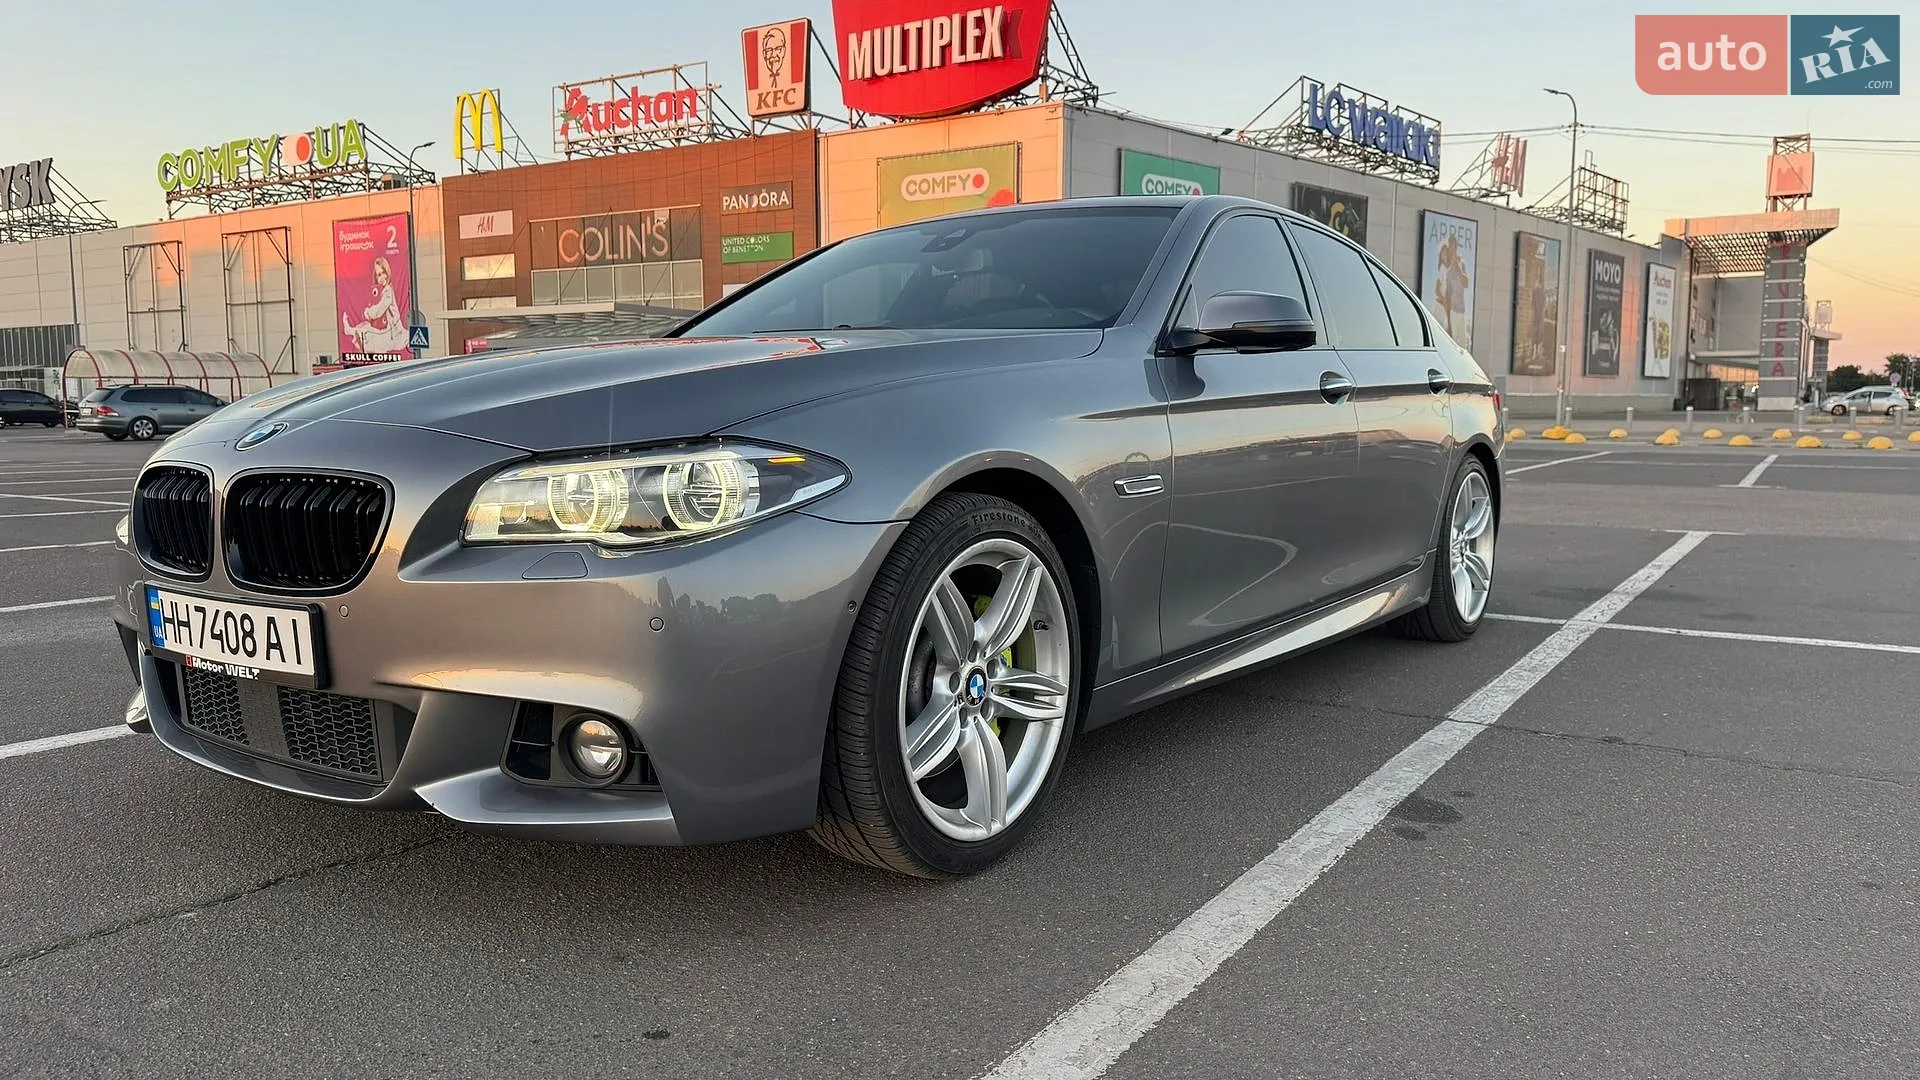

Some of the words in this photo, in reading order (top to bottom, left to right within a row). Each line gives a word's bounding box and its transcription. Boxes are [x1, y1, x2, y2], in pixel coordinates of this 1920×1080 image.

[849, 5, 1004, 81] MULTIPLEX
[756, 87, 796, 111] KFC
[560, 86, 697, 136] Auchan
[157, 133, 279, 192] COMFY
[315, 118, 367, 168] UA
[905, 173, 971, 196] COMFY
[1145, 178, 1192, 195] COMFY
[386, 225, 398, 248] 2
[558, 215, 669, 264] COLIN'S
[1594, 259, 1621, 285] MOYO
[345, 353, 371, 361] SKULL
[971, 511, 1026, 528] Firestone
[192, 656, 224, 674] Motor
